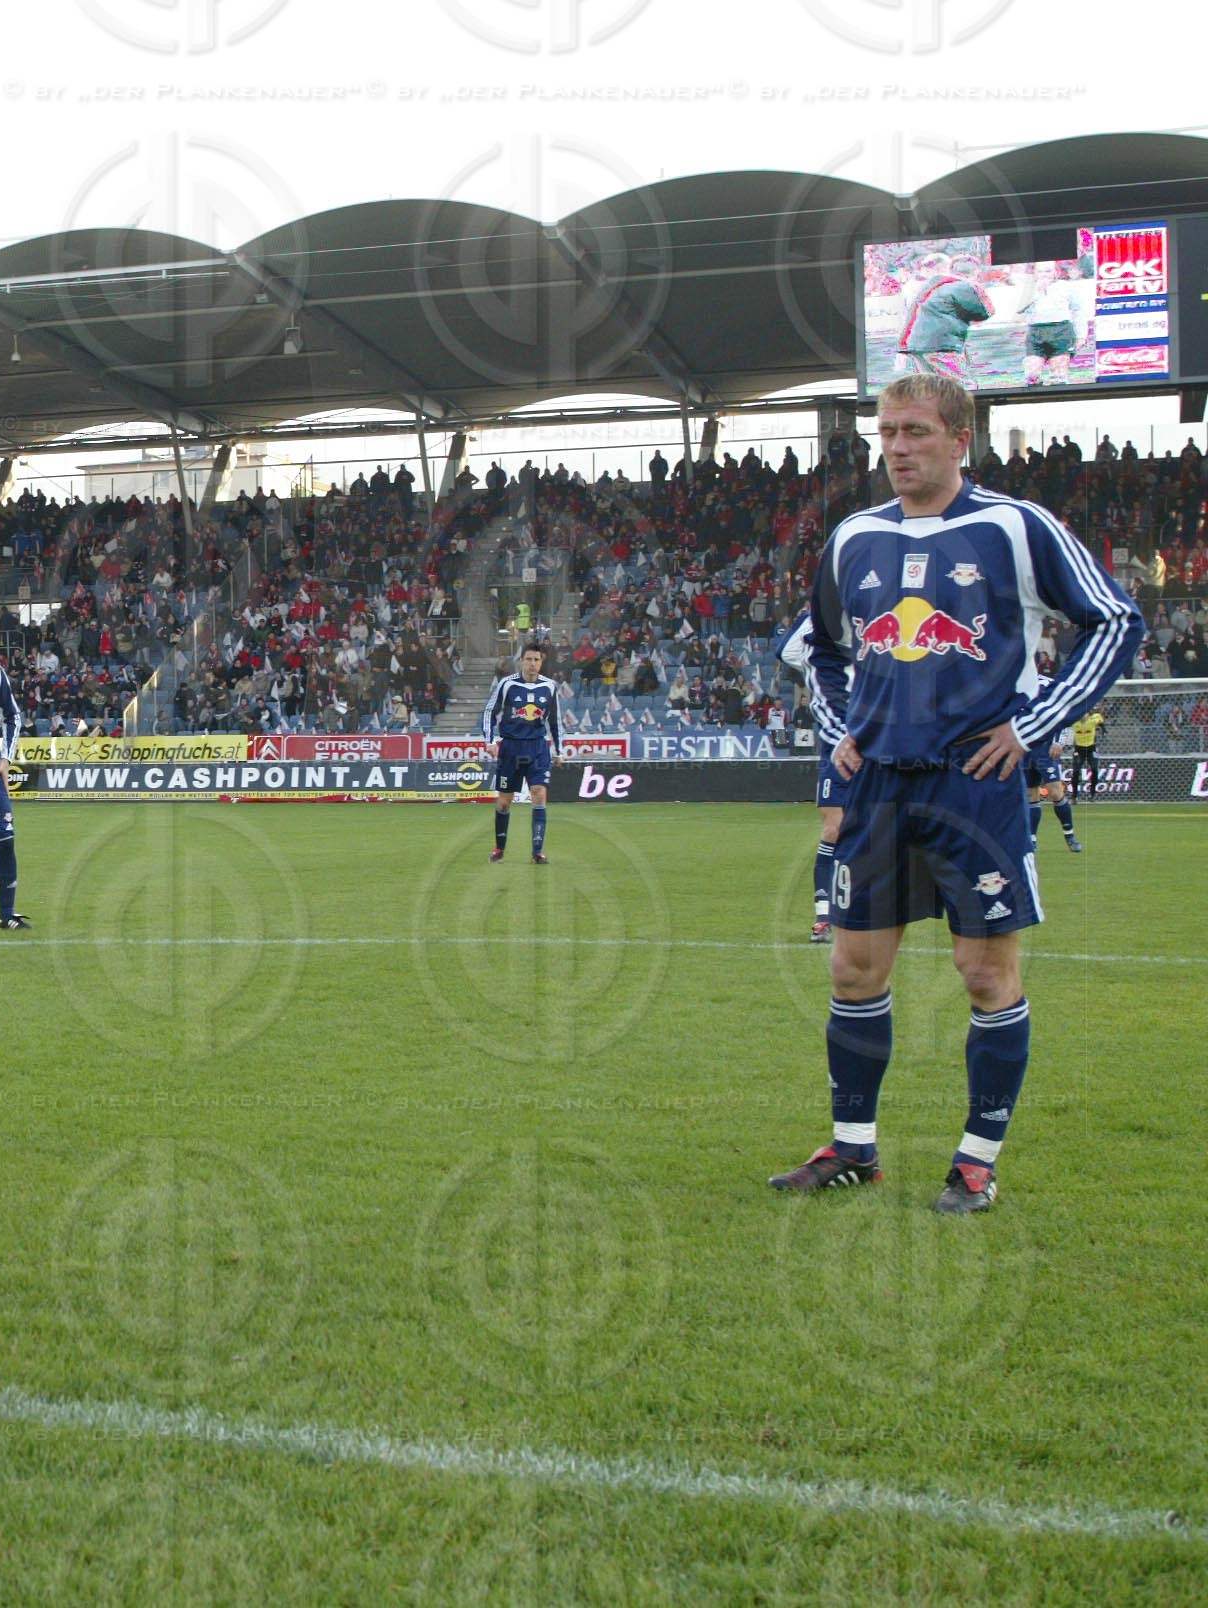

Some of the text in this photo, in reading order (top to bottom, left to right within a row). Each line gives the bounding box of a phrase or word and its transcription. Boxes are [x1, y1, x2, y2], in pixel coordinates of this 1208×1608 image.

[98, 742, 242, 763] Shoppingfuchs.at
[315, 739, 381, 751] CITROËN
[643, 735, 776, 759] FESTINA
[46, 766, 409, 789] WWW.CASHPOINT.AT
[428, 772, 489, 781] CASHPOINT
[579, 766, 633, 798] be
[832, 859, 852, 910] 19
